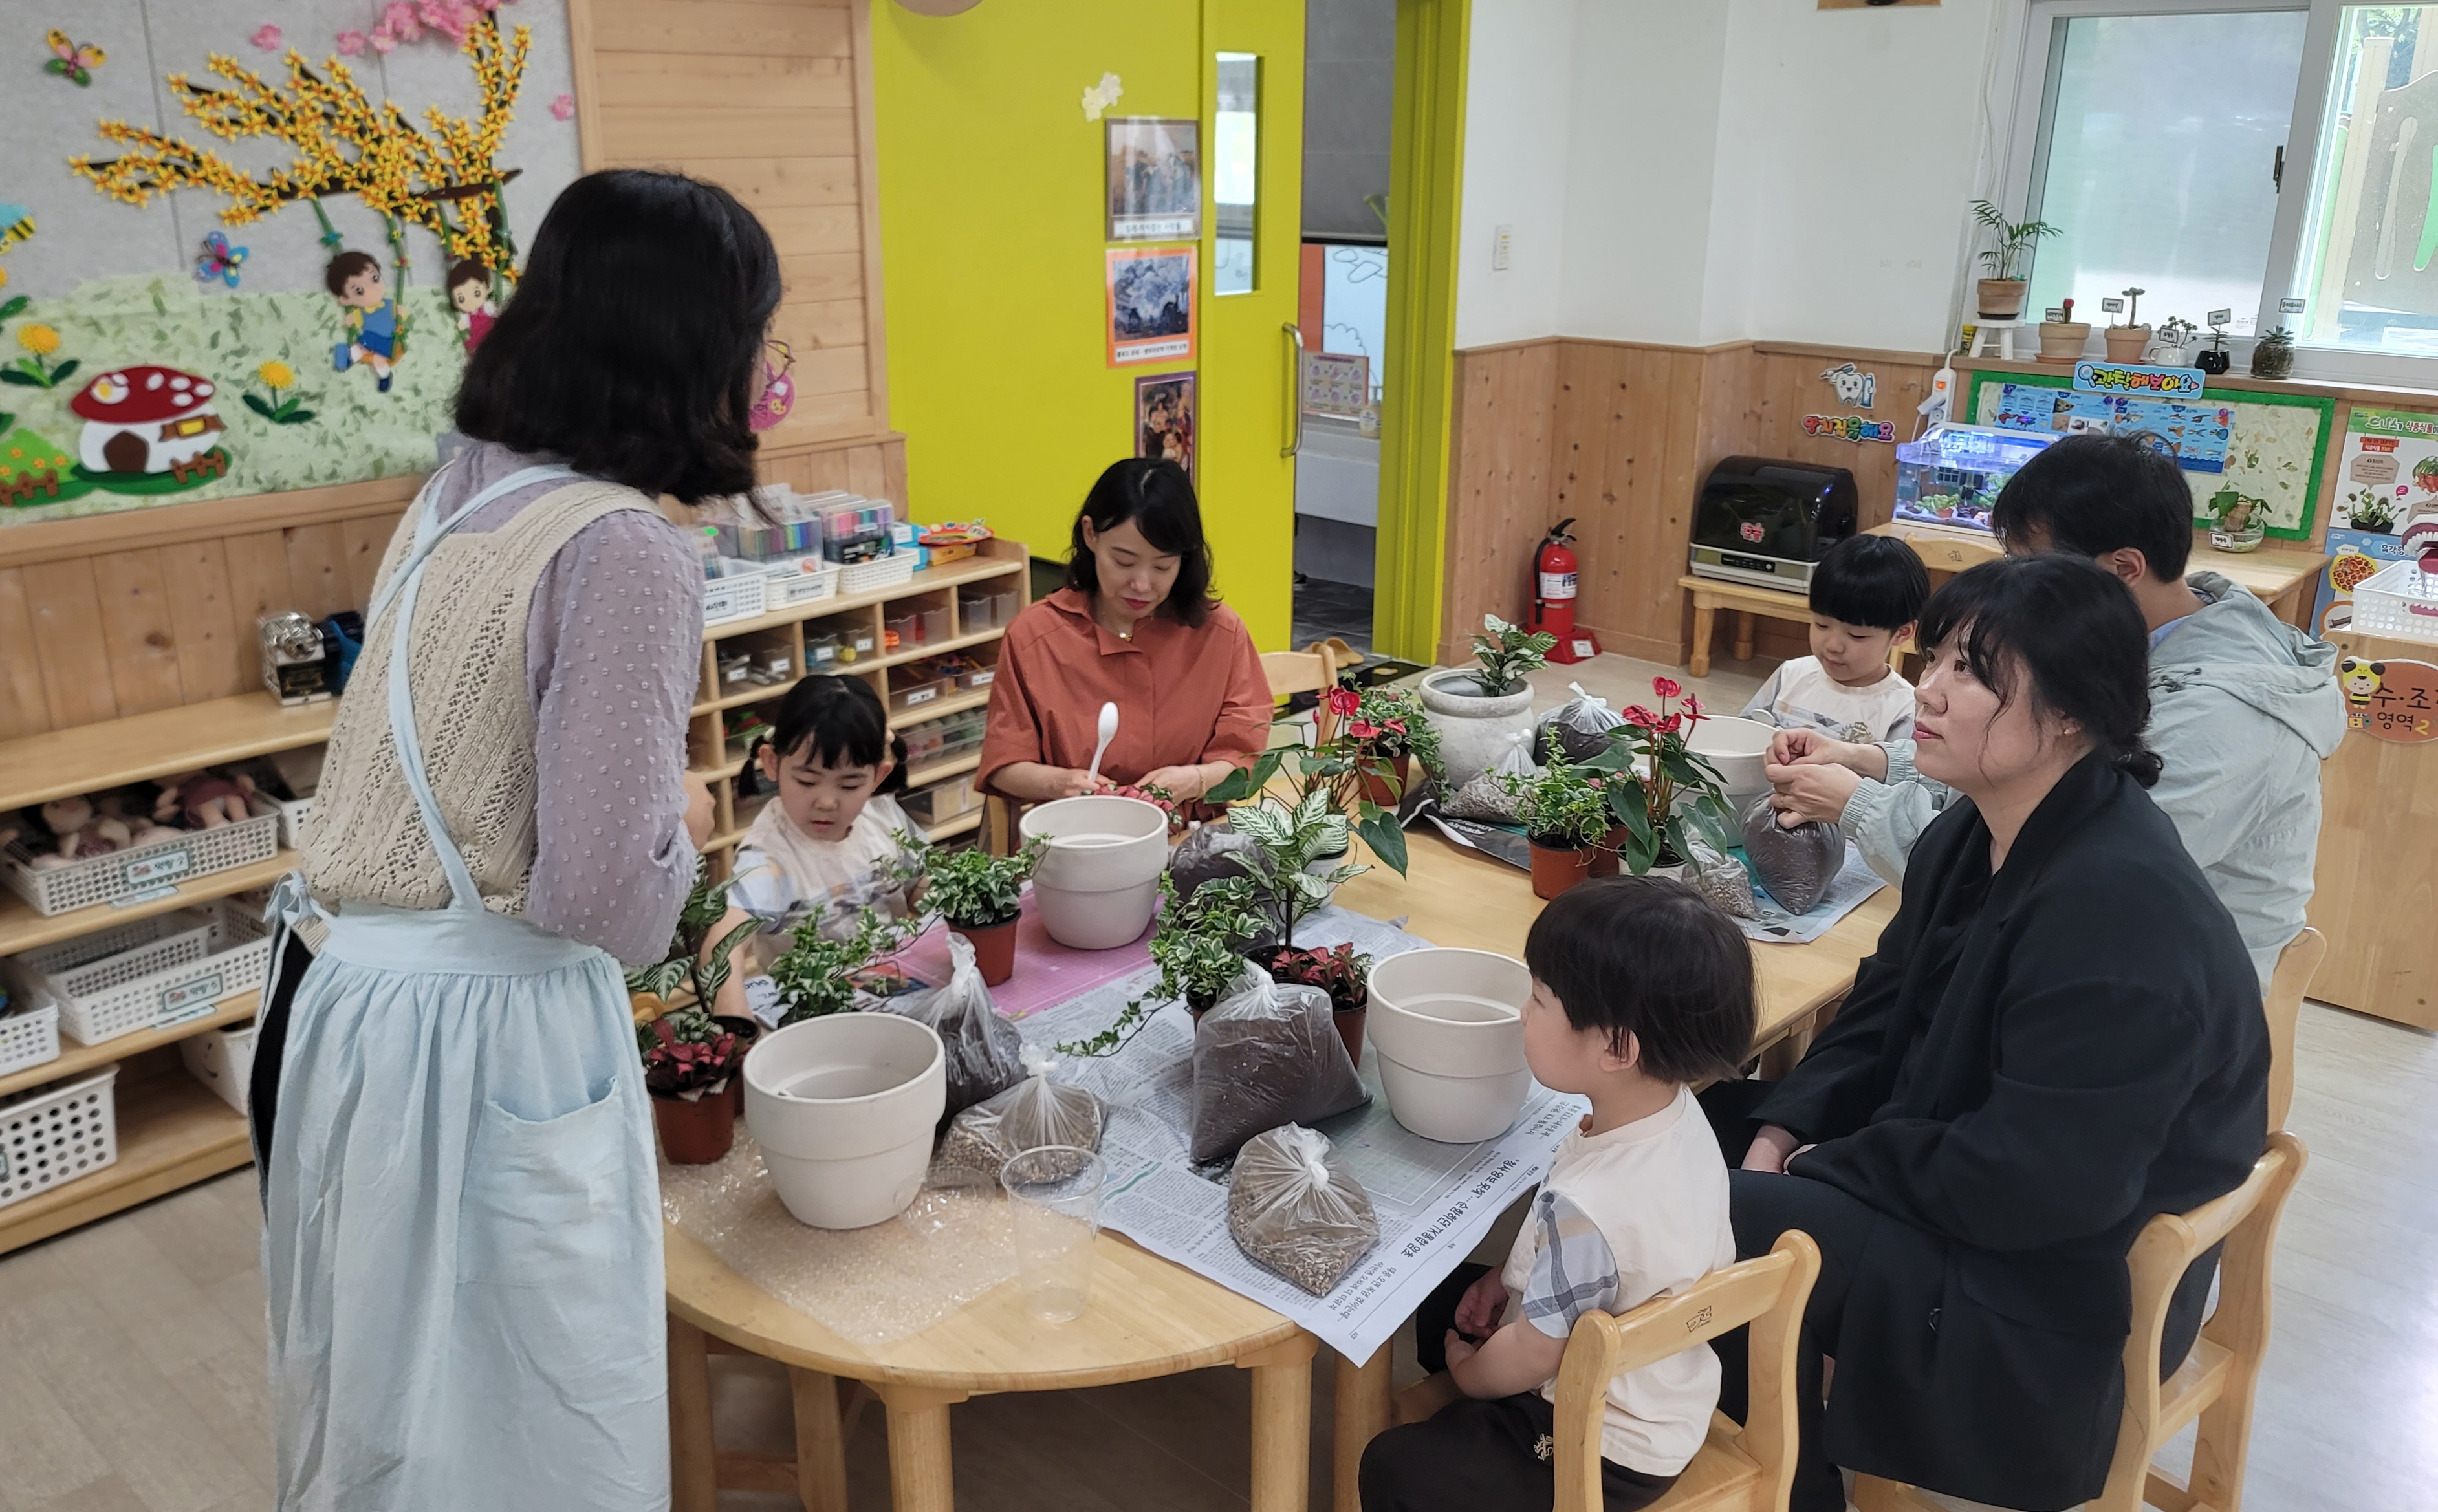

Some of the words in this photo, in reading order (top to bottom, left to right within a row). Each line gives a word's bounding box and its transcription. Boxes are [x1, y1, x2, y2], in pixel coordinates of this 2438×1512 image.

[2094, 369, 2193, 393] 관찰해보아요
[1803, 415, 1893, 442] 양치질을해요
[2377, 711, 2413, 732] 영역
[2415, 719, 2430, 736] 2
[1485, 1168, 1504, 1183] 양보
[1414, 1224, 1444, 1246] TK통합
[1400, 1242, 1420, 1257] 암초
[1382, 1267, 1397, 1278] 태풍
[1371, 1276, 1385, 1288] 오면
[1360, 1286, 1375, 1298] 폭염
